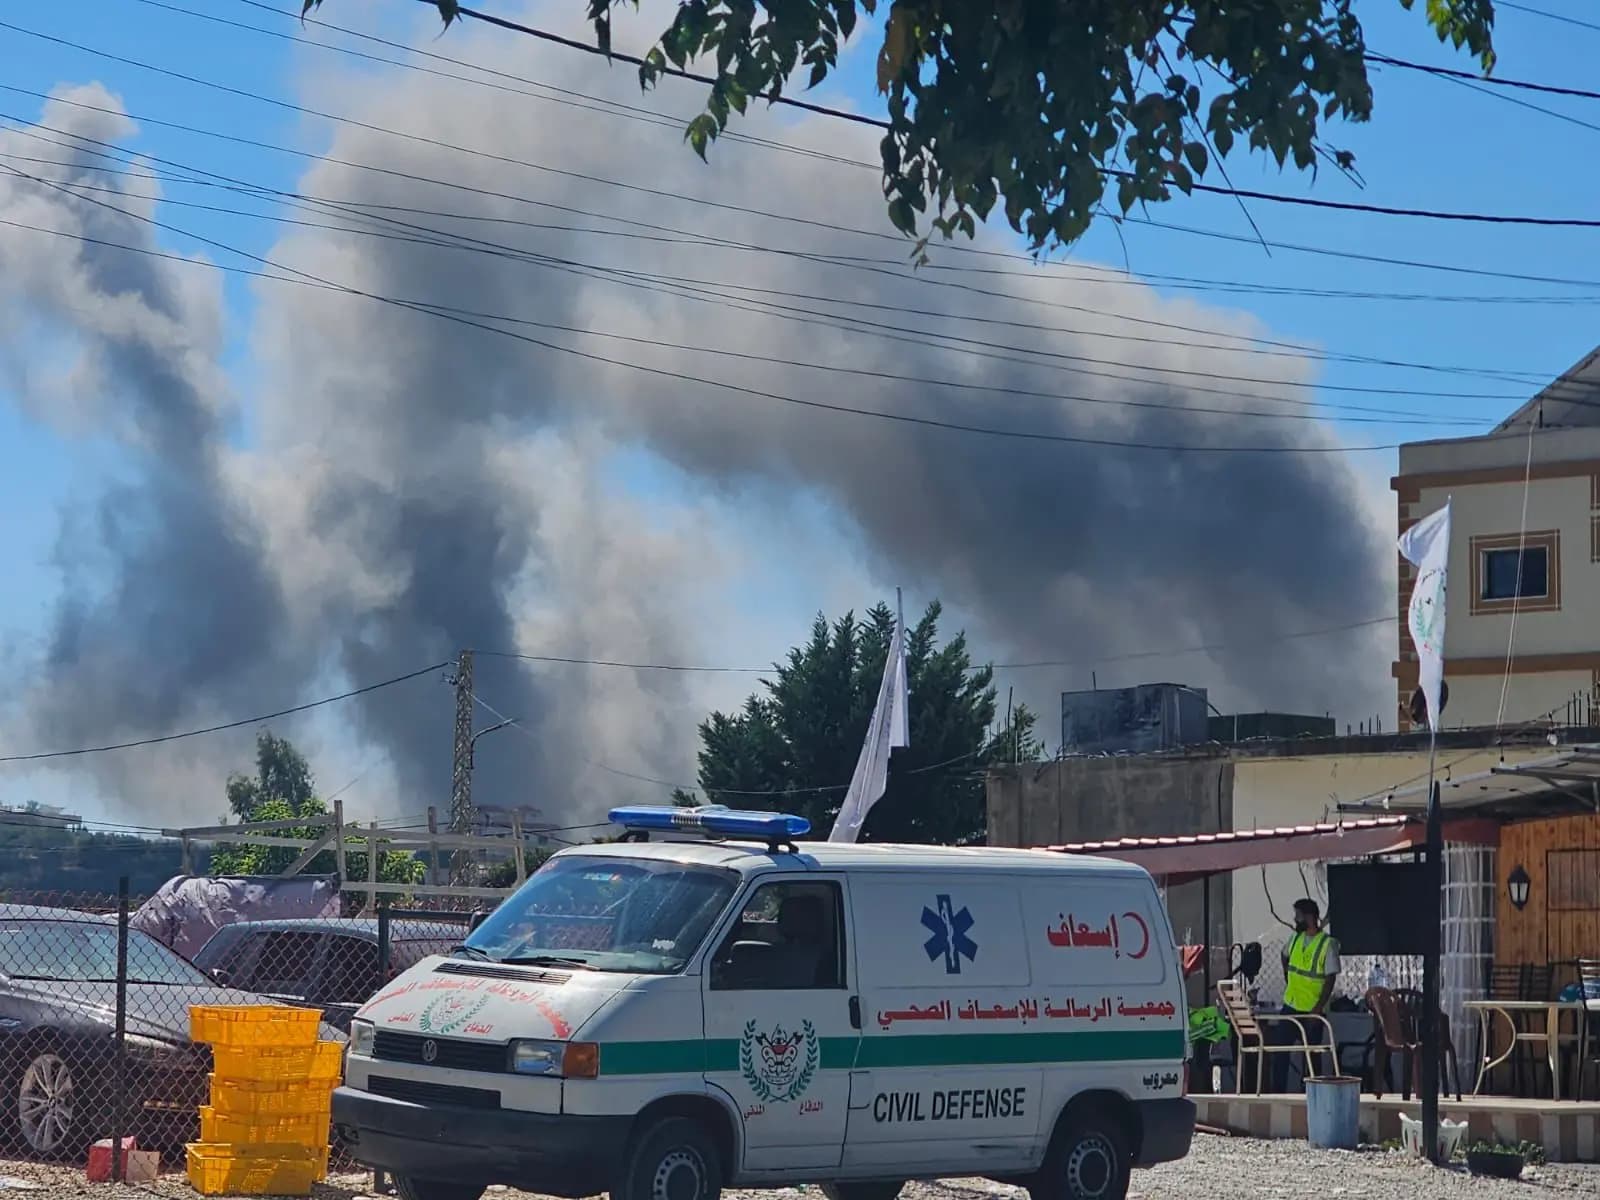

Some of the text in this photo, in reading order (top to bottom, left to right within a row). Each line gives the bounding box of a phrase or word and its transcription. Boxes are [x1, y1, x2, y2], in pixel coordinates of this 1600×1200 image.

[1047, 911, 1121, 960] إسعاف
[877, 995, 1176, 1030] جمعية الرسالة للإسعاف الصحي
[873, 1087, 1026, 1123] CIVIL DEFENSE
